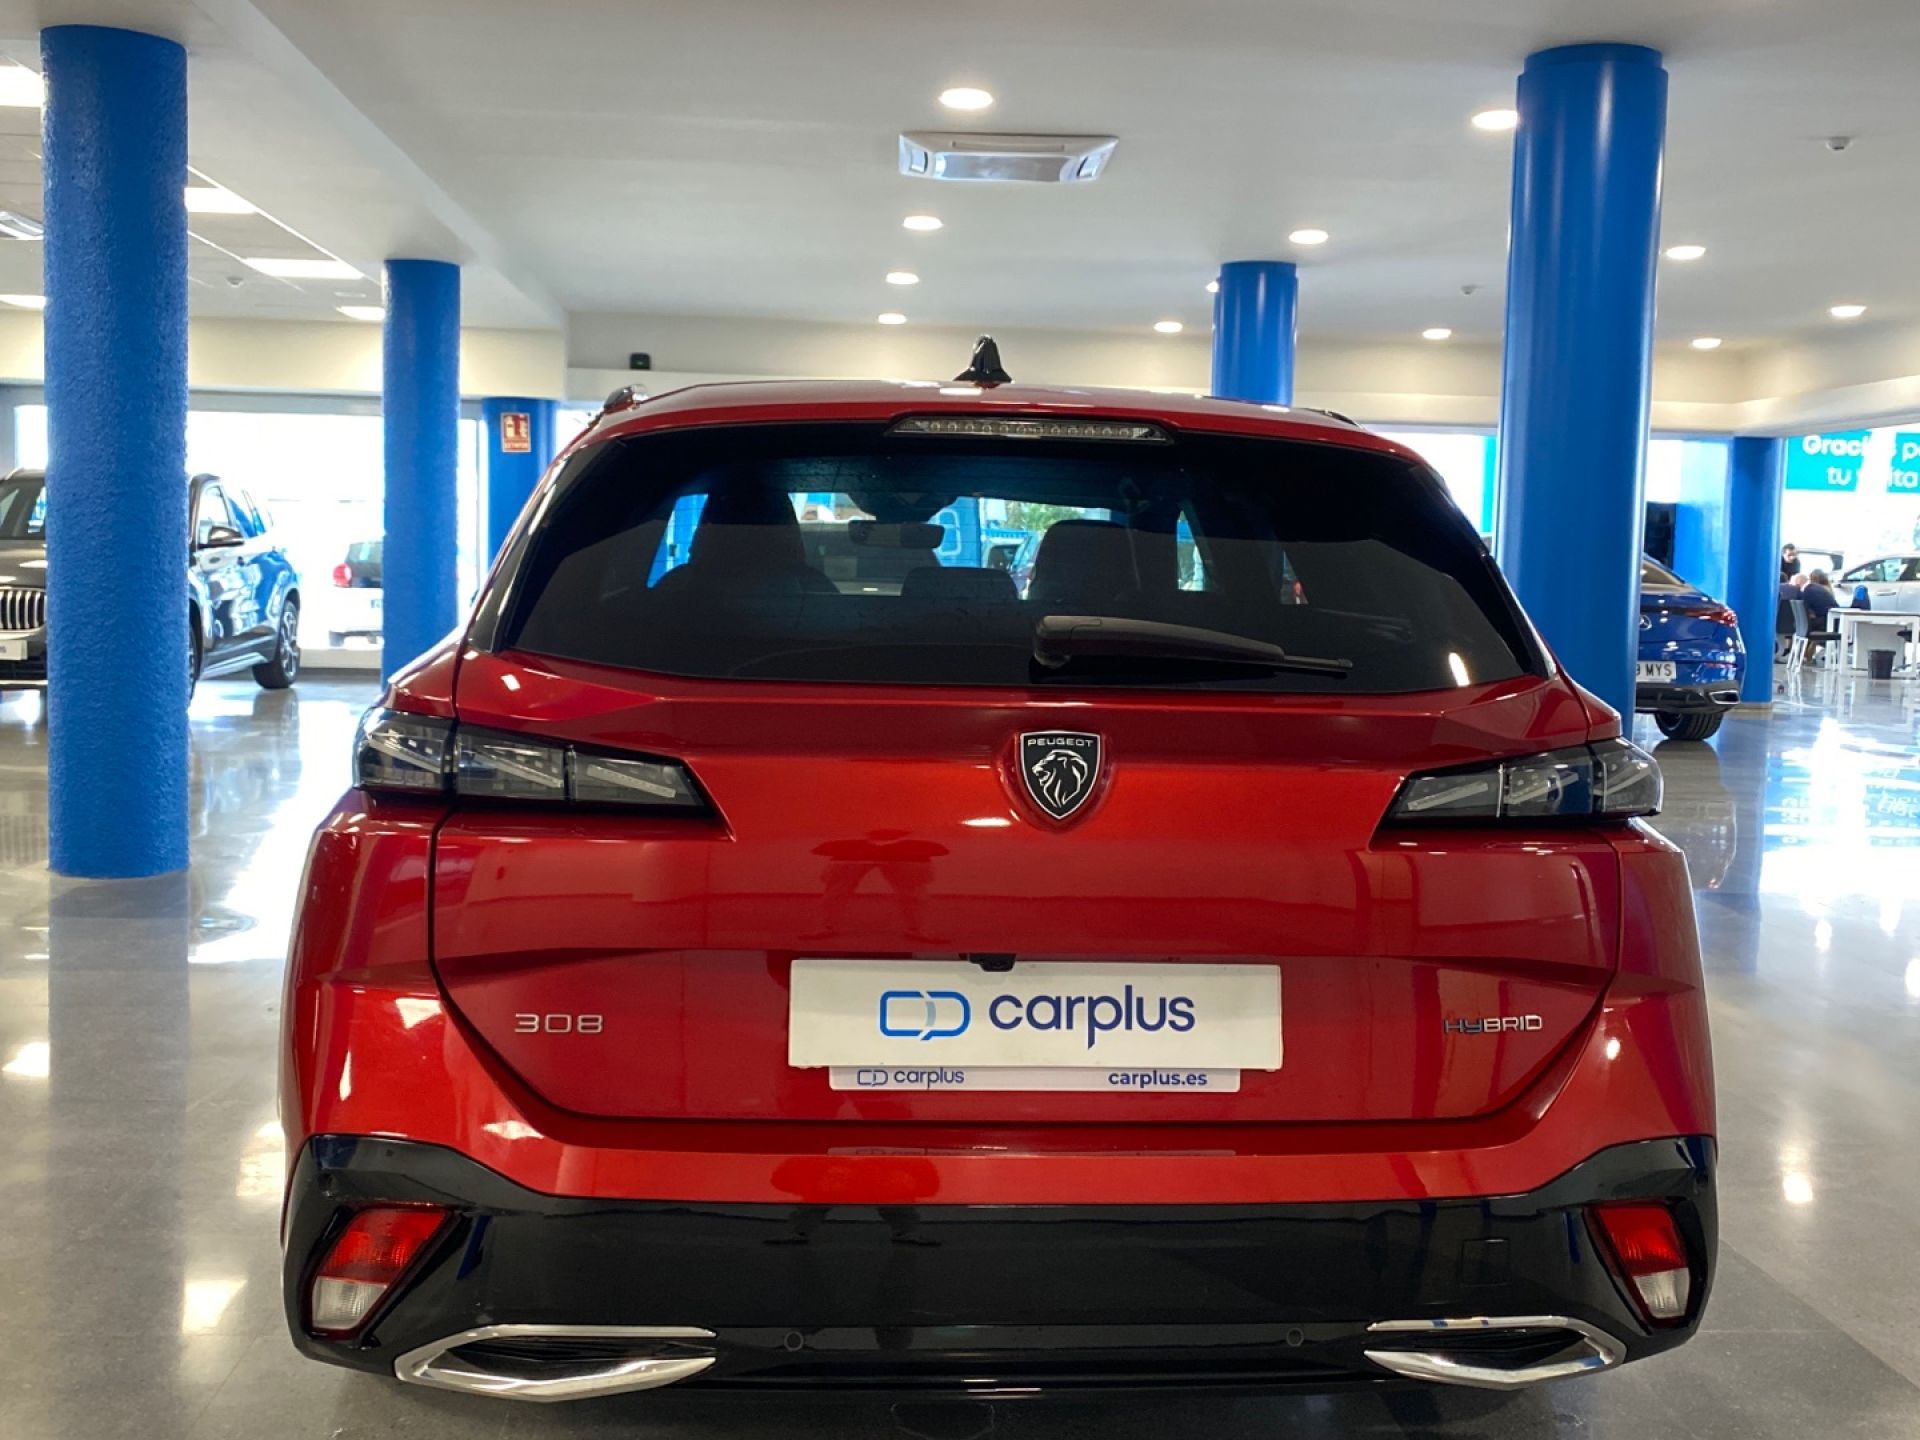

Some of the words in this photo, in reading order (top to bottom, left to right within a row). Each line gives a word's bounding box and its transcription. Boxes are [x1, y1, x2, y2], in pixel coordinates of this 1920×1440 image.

[1828, 467, 1851, 485] tu
[1645, 663, 1673, 677] MYS
[1027, 737, 1094, 748] PEUGEOT
[513, 1012, 604, 1034] 308
[988, 984, 1196, 1050] carplus
[1444, 1014, 1543, 1034] HYBRID
[893, 1067, 965, 1089] carplus
[1108, 1069, 1208, 1089] carplus.es
